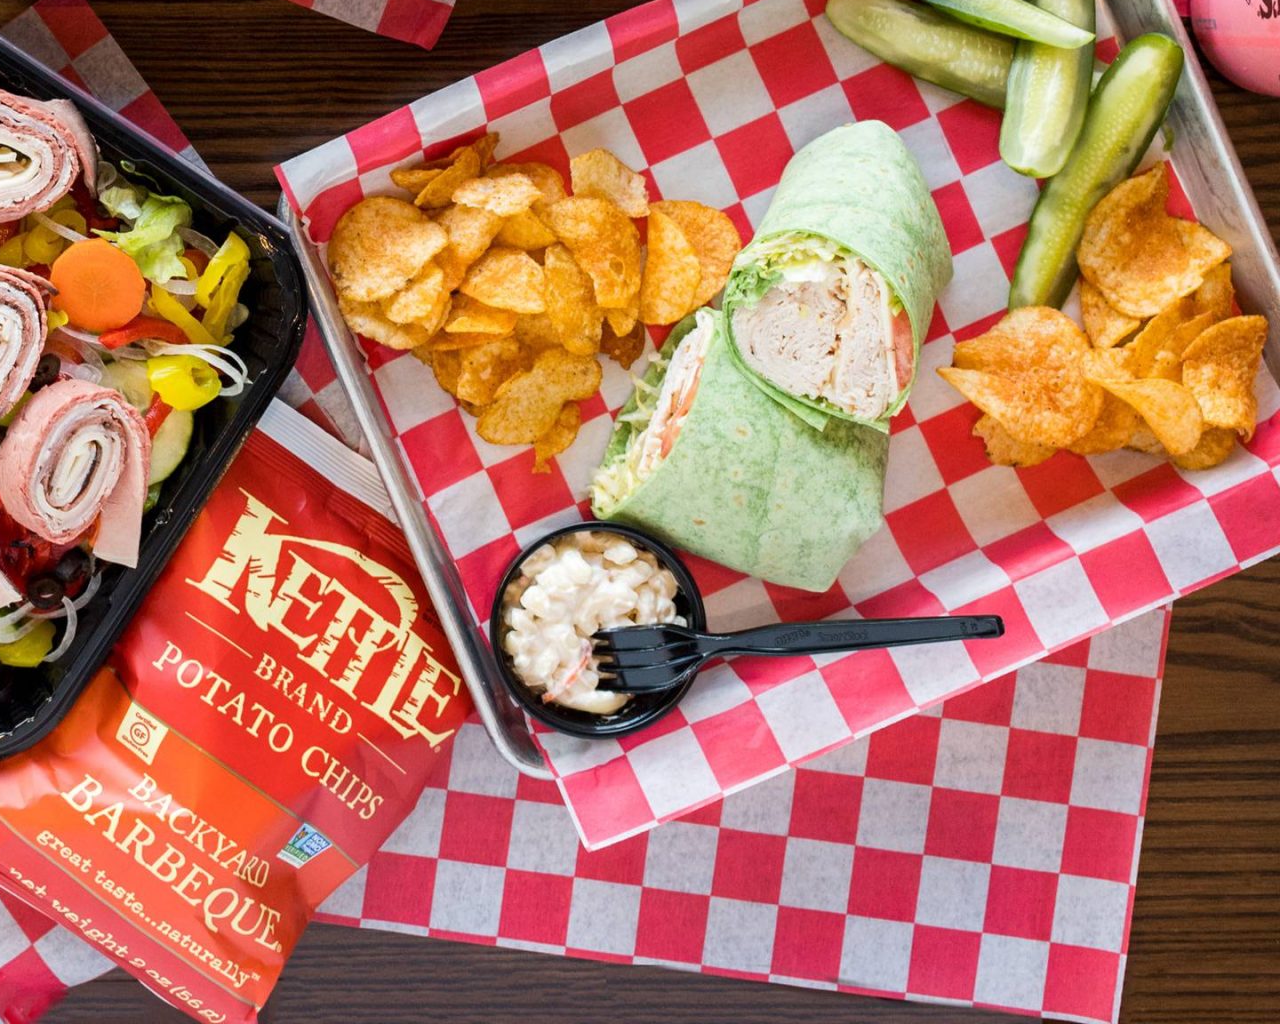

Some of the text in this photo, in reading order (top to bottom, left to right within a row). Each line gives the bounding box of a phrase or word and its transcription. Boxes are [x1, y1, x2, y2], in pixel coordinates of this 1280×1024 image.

[185, 487, 462, 748] KETTLE
[134, 728, 146, 739] GF
[152, 640, 384, 820] POTATO CHIPS
[253, 653, 353, 735] BRAND
[36, 829, 93, 874] great
[60, 773, 281, 952] BARBEQUE
[128, 773, 270, 888] BACKYARD
[9, 867, 50, 899] net
[51, 899, 130, 957] weight
[128, 957, 148, 970] 2
[144, 968, 174, 988] oz
